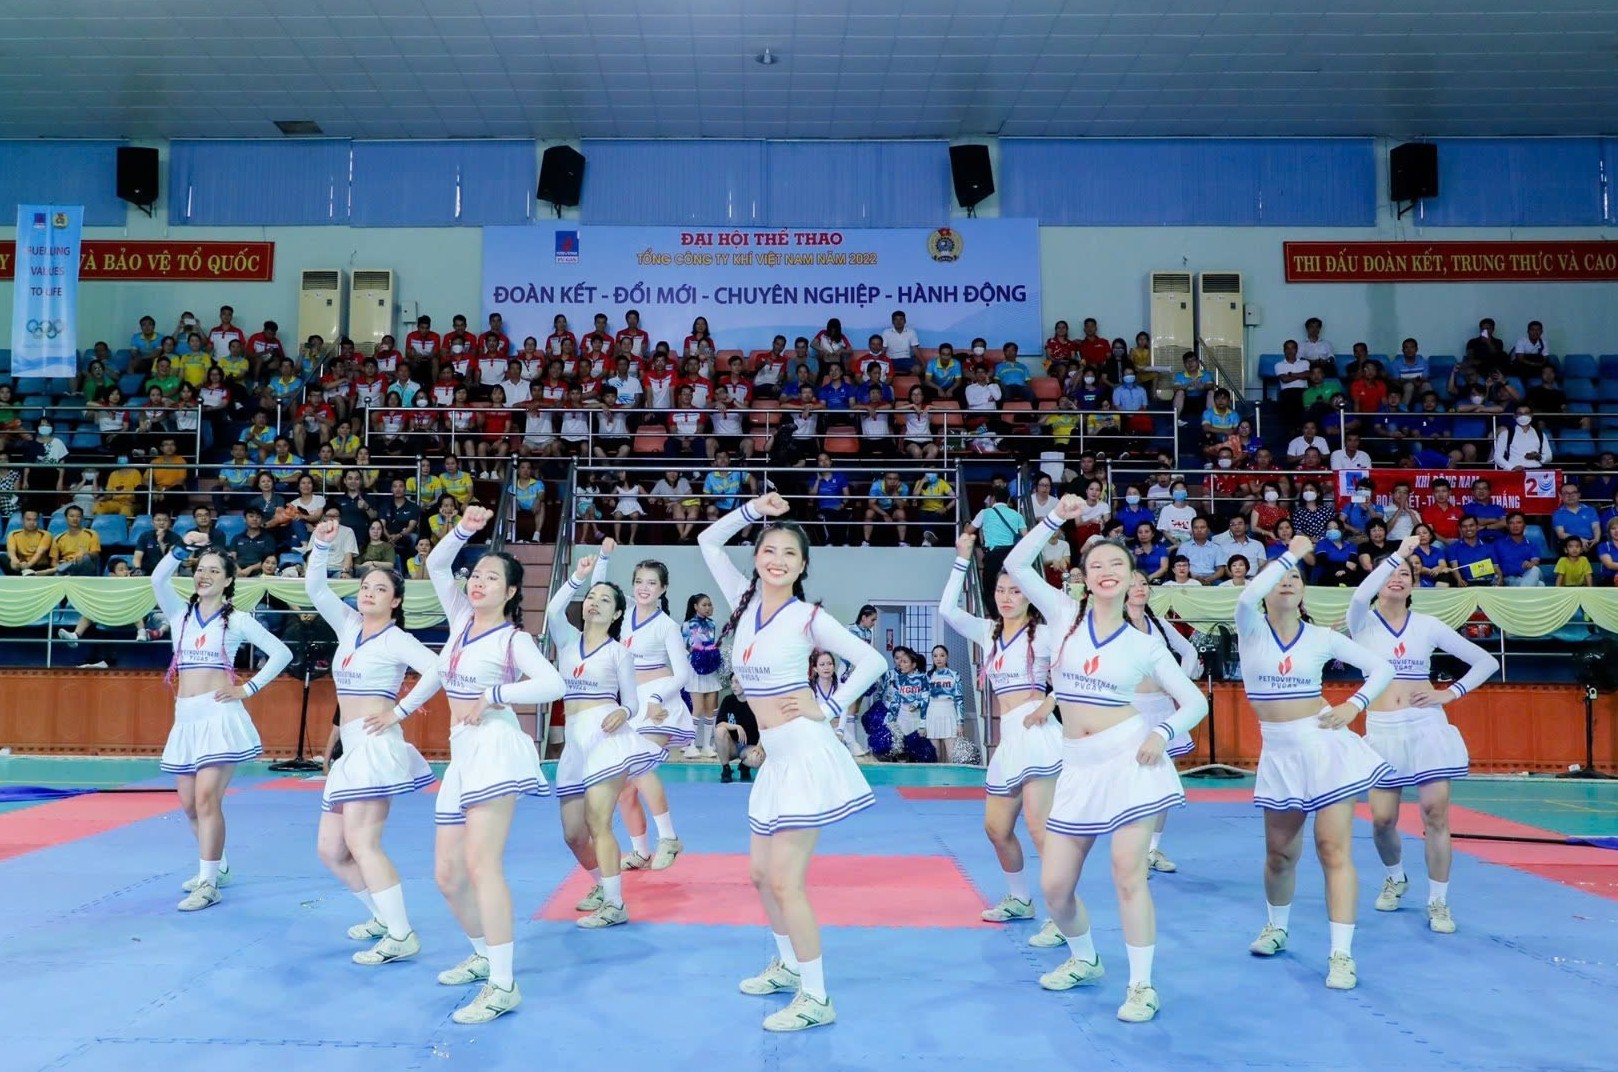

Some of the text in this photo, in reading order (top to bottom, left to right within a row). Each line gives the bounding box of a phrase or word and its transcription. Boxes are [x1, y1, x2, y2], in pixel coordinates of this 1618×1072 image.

[681, 228, 843, 248] ĐẠI HỘI THỂ THAO
[103, 247, 142, 270] BẢO
[147, 250, 171, 274] VỆ
[177, 247, 201, 271] TỔ
[207, 247, 260, 274] QUỐC
[637, 248, 878, 267] TỔNG CÔNG TY KHÍ VIỆT NAM NĂM 2022
[1293, 247, 1616, 275] THI ĐẤU ĐOÀN KẾT, TRUNG THỰC VÀ CAO
[31, 266, 65, 276] VALUES
[31, 287, 62, 296] TO LIFE
[493, 283, 555, 304] ĐOÀN
[560, 281, 597, 304] KẾT
[613, 281, 651, 304] ĐỔI
[656, 283, 697, 304] MỚI
[714, 283, 798, 304] CHUYÊN
[804, 283, 881, 308] NGHIỆP
[898, 282, 958, 303] HÀNH
[963, 282, 1027, 306] ĐỘNG
[1415, 472, 1430, 488] KHÍ
[1062, 672, 1118, 690] PETROVIETNAM
[1258, 675, 1312, 685] PETROVIETNAM
